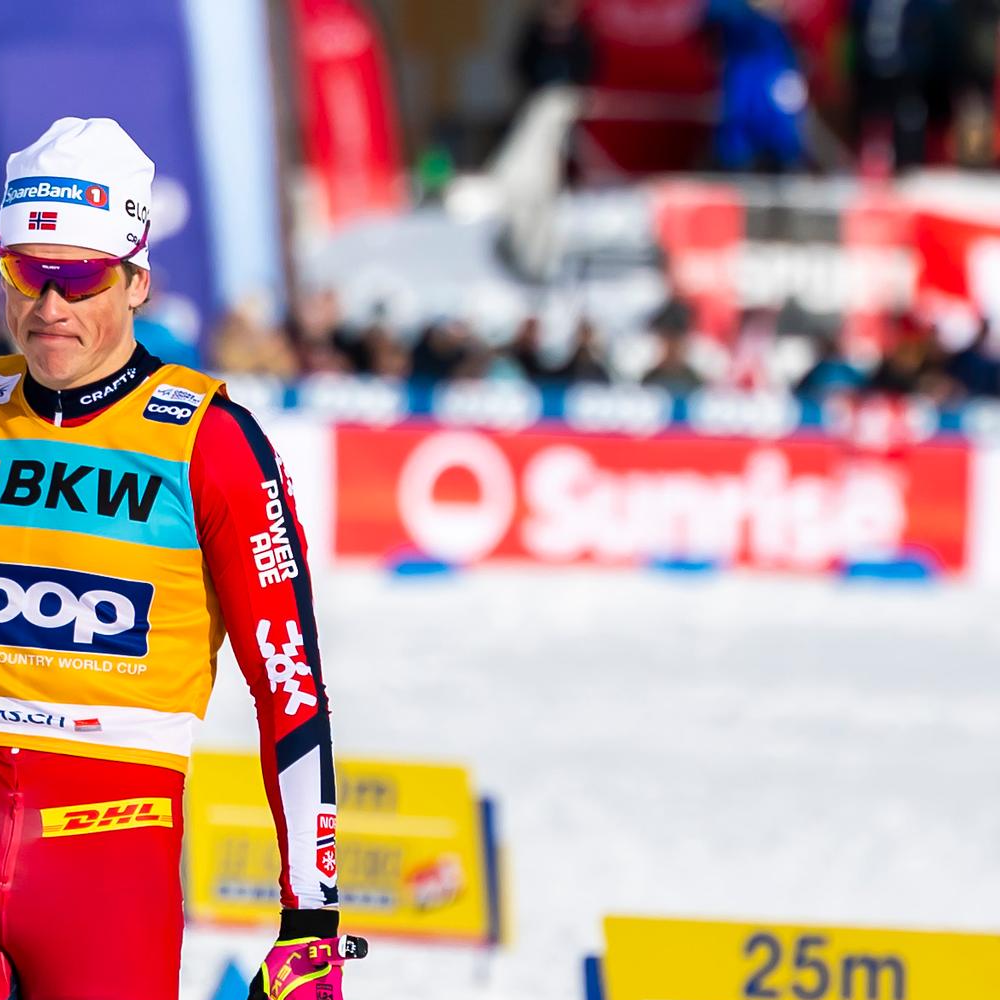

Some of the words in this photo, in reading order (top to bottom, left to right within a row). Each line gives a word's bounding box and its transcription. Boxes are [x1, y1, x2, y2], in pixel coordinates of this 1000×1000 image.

[7, 182, 83, 203] SpareBank
[125, 199, 150, 224] elo
[80, 373, 127, 405] CRAFT
[147, 403, 192, 420] coop
[0, 459, 162, 523] BKW
[261, 479, 299, 582] POWER
[249, 532, 281, 588] ADE
[58, 658, 113, 672] WORLD
[117, 663, 148, 675] CUP
[63, 803, 160, 831] DHL
[320, 815, 336, 829] NO
